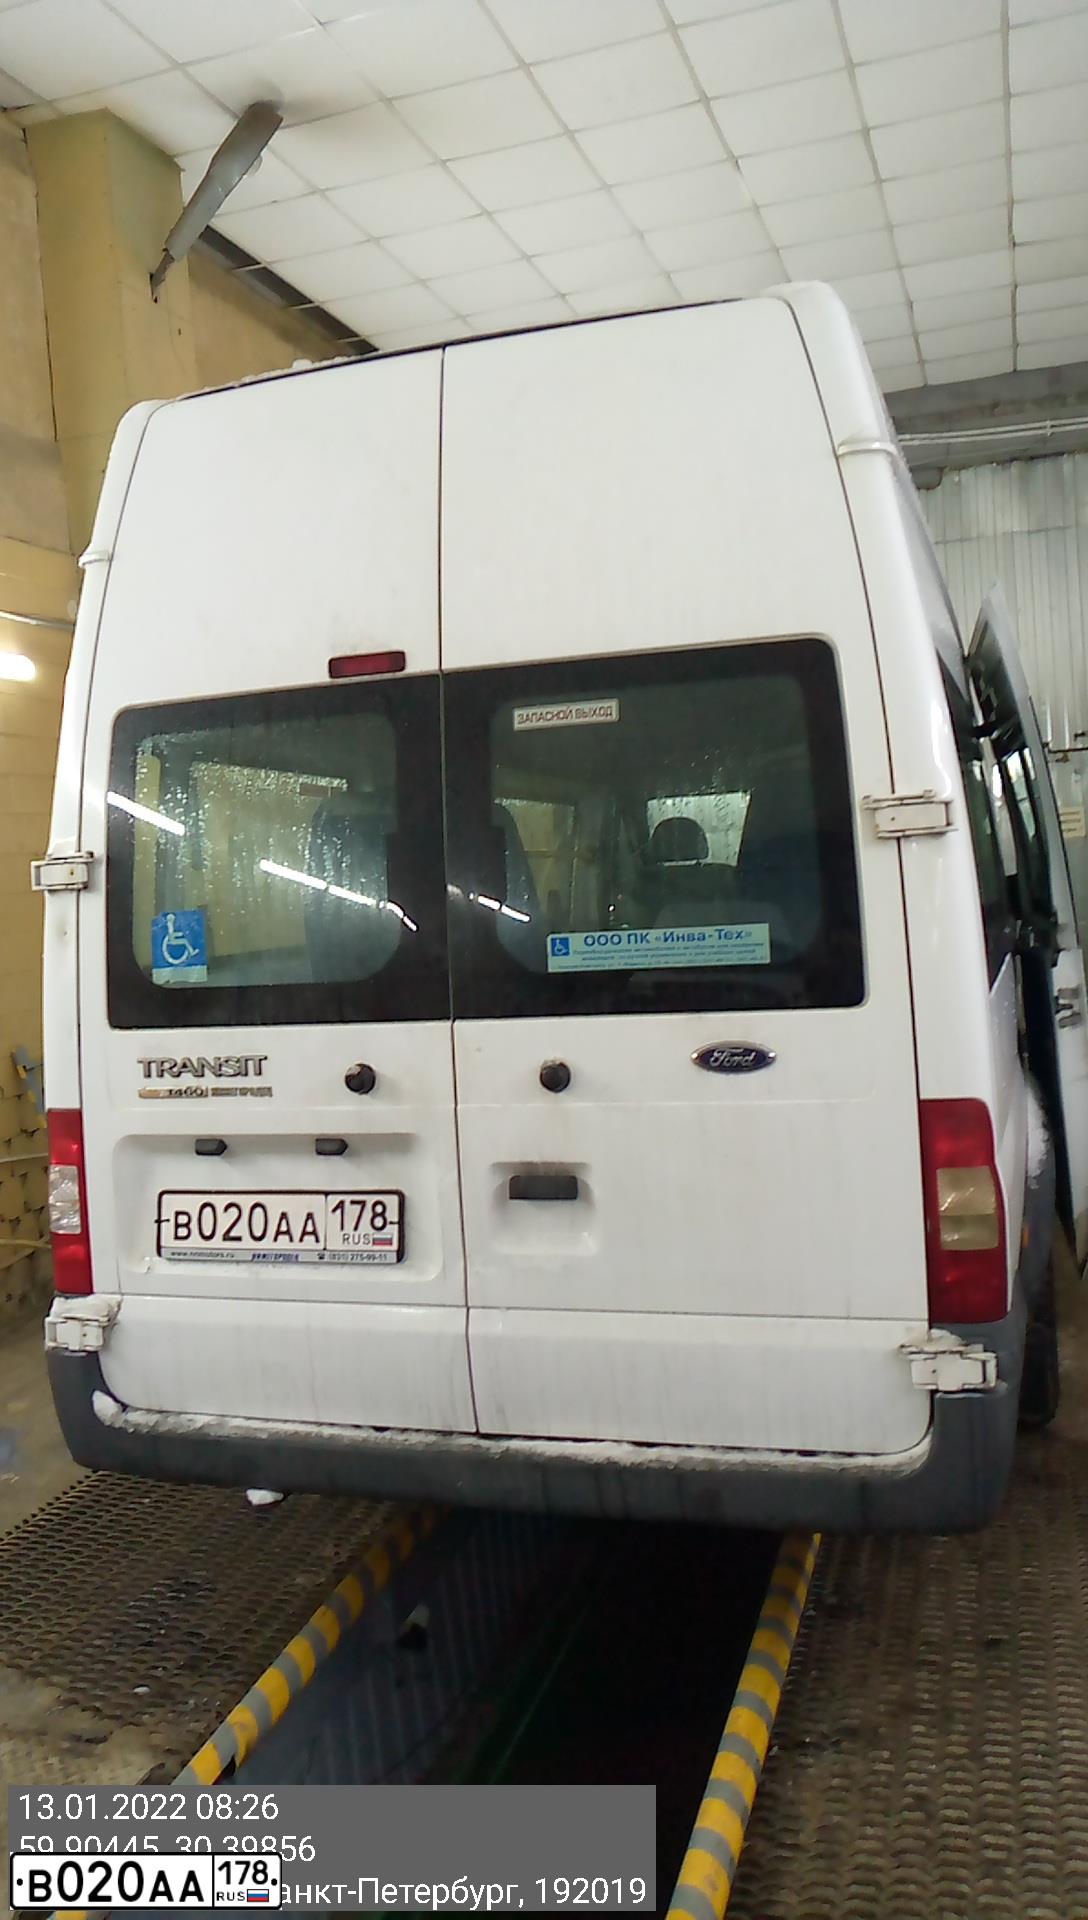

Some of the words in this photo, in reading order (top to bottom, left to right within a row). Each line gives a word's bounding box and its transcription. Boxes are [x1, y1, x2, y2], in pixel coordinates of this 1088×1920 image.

[517, 705, 574, 725] ЗАПАСНОЙ
[575, 704, 613, 719] ВЫХОД
[583, 932, 623, 947] ООО
[627, 931, 651, 945] ПК
[654, 928, 753, 944] «Инва-Тех»
[137, 1055, 268, 1079] TRANSIT
[709, 1047, 757, 1067] Ford
[331, 1199, 388, 1232] 178
[342, 1233, 371, 1245] RUS
